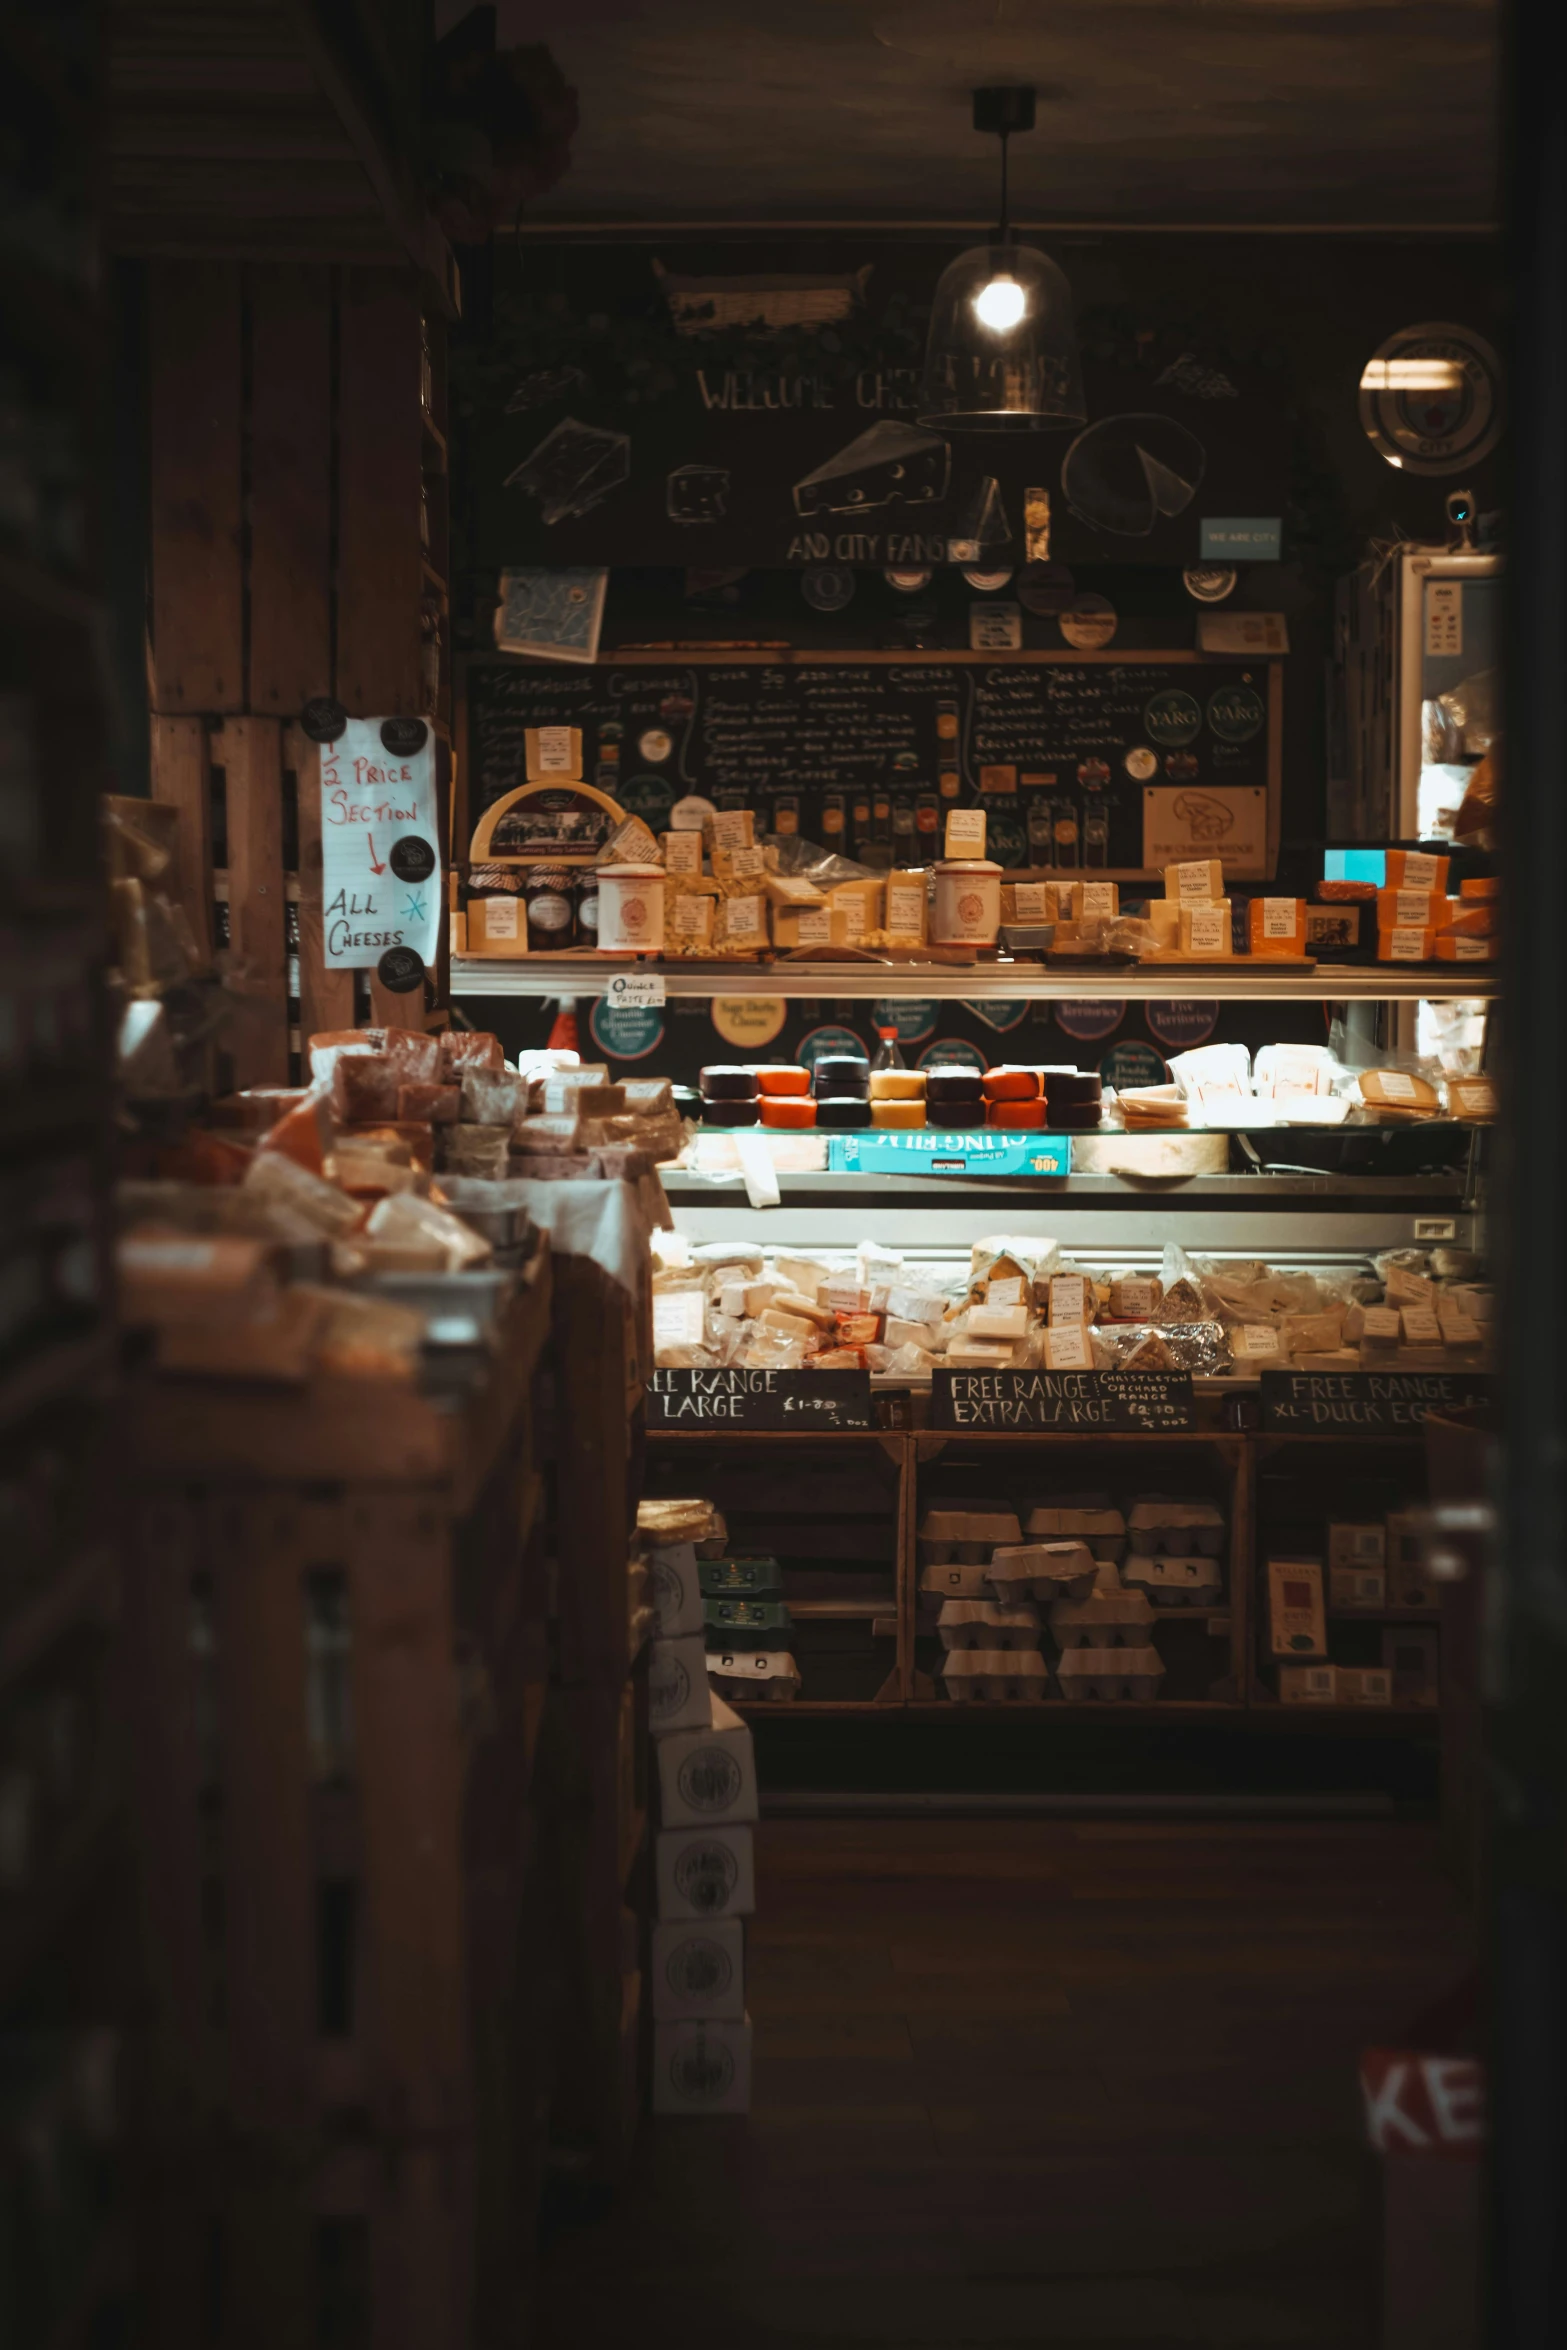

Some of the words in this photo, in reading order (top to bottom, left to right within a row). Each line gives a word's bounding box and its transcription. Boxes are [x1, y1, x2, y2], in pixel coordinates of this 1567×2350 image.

[1418, 439, 1454, 454] CITY
[1208, 532, 1225, 542] WE
[1228, 532, 1250, 542] ARE
[787, 535, 829, 561] AND
[834, 535, 880, 560] CITY
[887, 534, 945, 562] FANS
[1149, 710, 1197, 727] YARG
[1211, 704, 1260, 721] YARG
[353, 757, 412, 785] PRICE
[328, 790, 418, 825] SECTION
[325, 888, 378, 917] ALL
[328, 920, 404, 956] CHEESES
[612, 978, 655, 993] QUINCE
[1059, 1005, 1117, 1020] Territories
[1155, 1011, 1212, 1026] Territories
[691, 1368, 778, 1394] RANGE
[951, 1376, 1003, 1400] FREE
[1013, 1375, 1091, 1400] RANGE
[1100, 1371, 1188, 1385] CHRISTLETON
[1291, 1376, 1357, 1400] FREE
[1368, 1376, 1453, 1400] RANGE
[1107, 1384, 1168, 1393] ORCHARD
[1118, 1392, 1168, 1401] RANGE
[663, 1395, 744, 1418] LARGE
[954, 1400, 1033, 1425] EXTRA
[1040, 1399, 1116, 1423] LARGE
